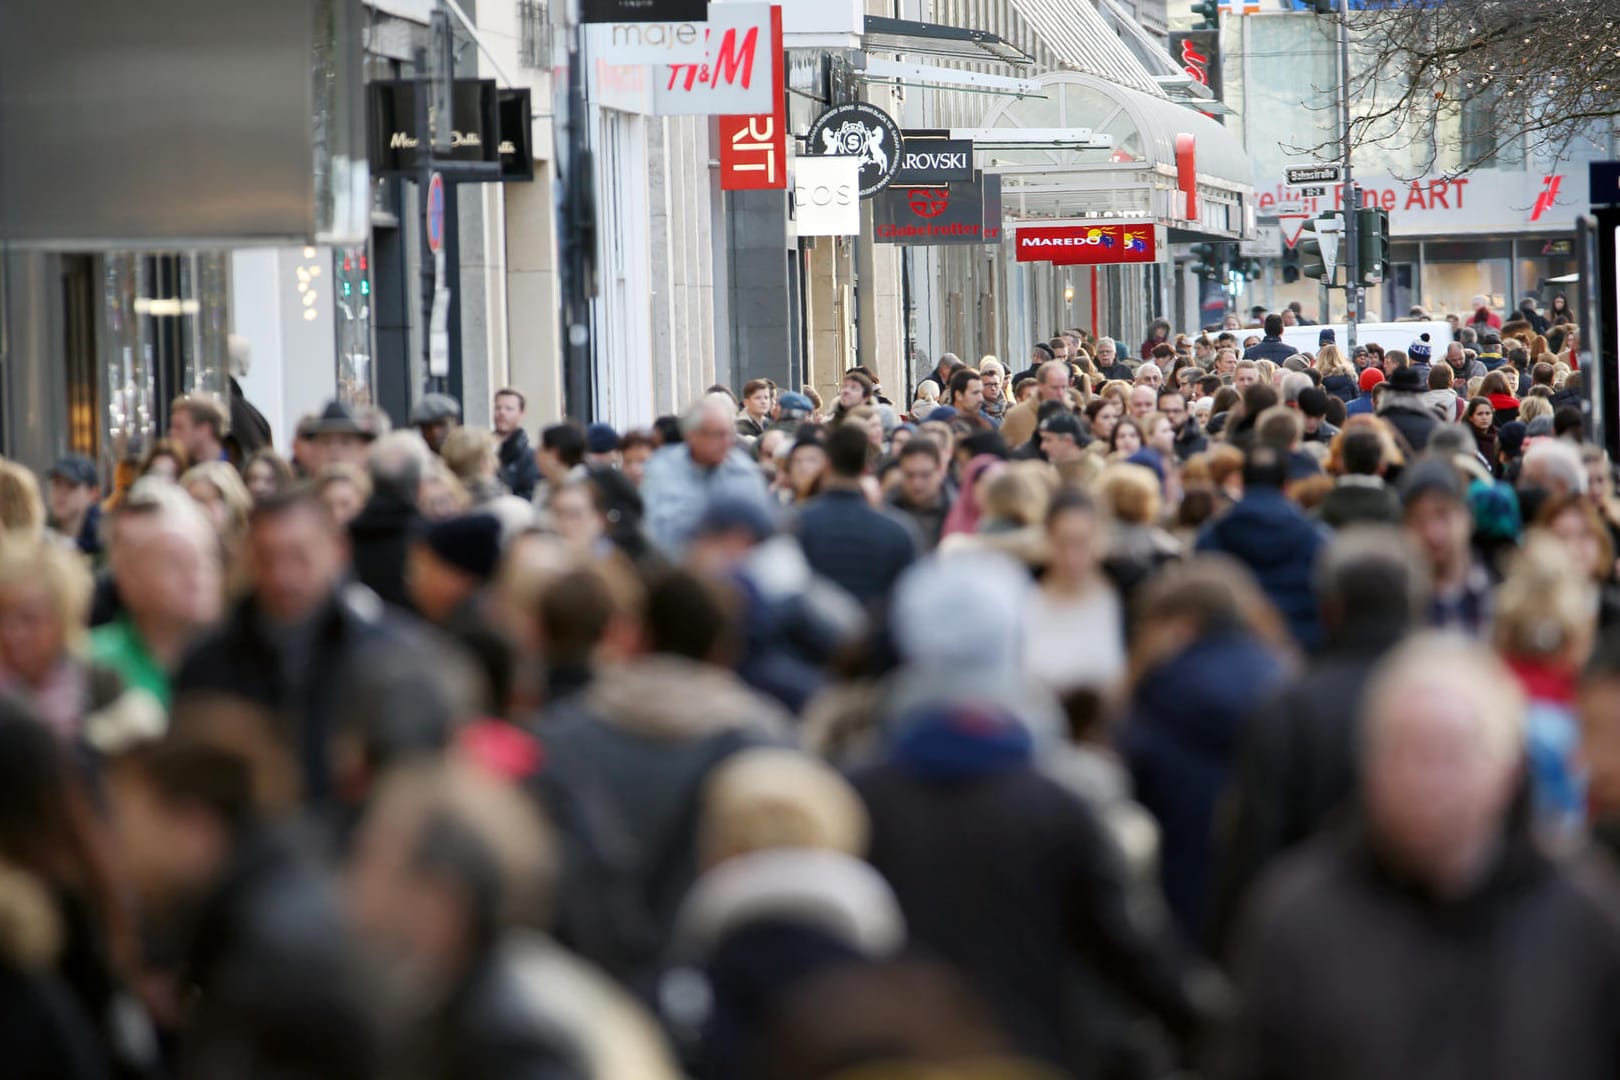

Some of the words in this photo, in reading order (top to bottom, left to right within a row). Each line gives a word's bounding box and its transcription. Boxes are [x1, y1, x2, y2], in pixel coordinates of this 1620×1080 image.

[612, 23, 697, 49] maje
[901, 153, 967, 169] ROVSKI
[795, 184, 851, 207] COS
[1404, 178, 1469, 211] ART
[877, 222, 981, 239] Globetrotter
[1022, 237, 1101, 247] MAREDO
